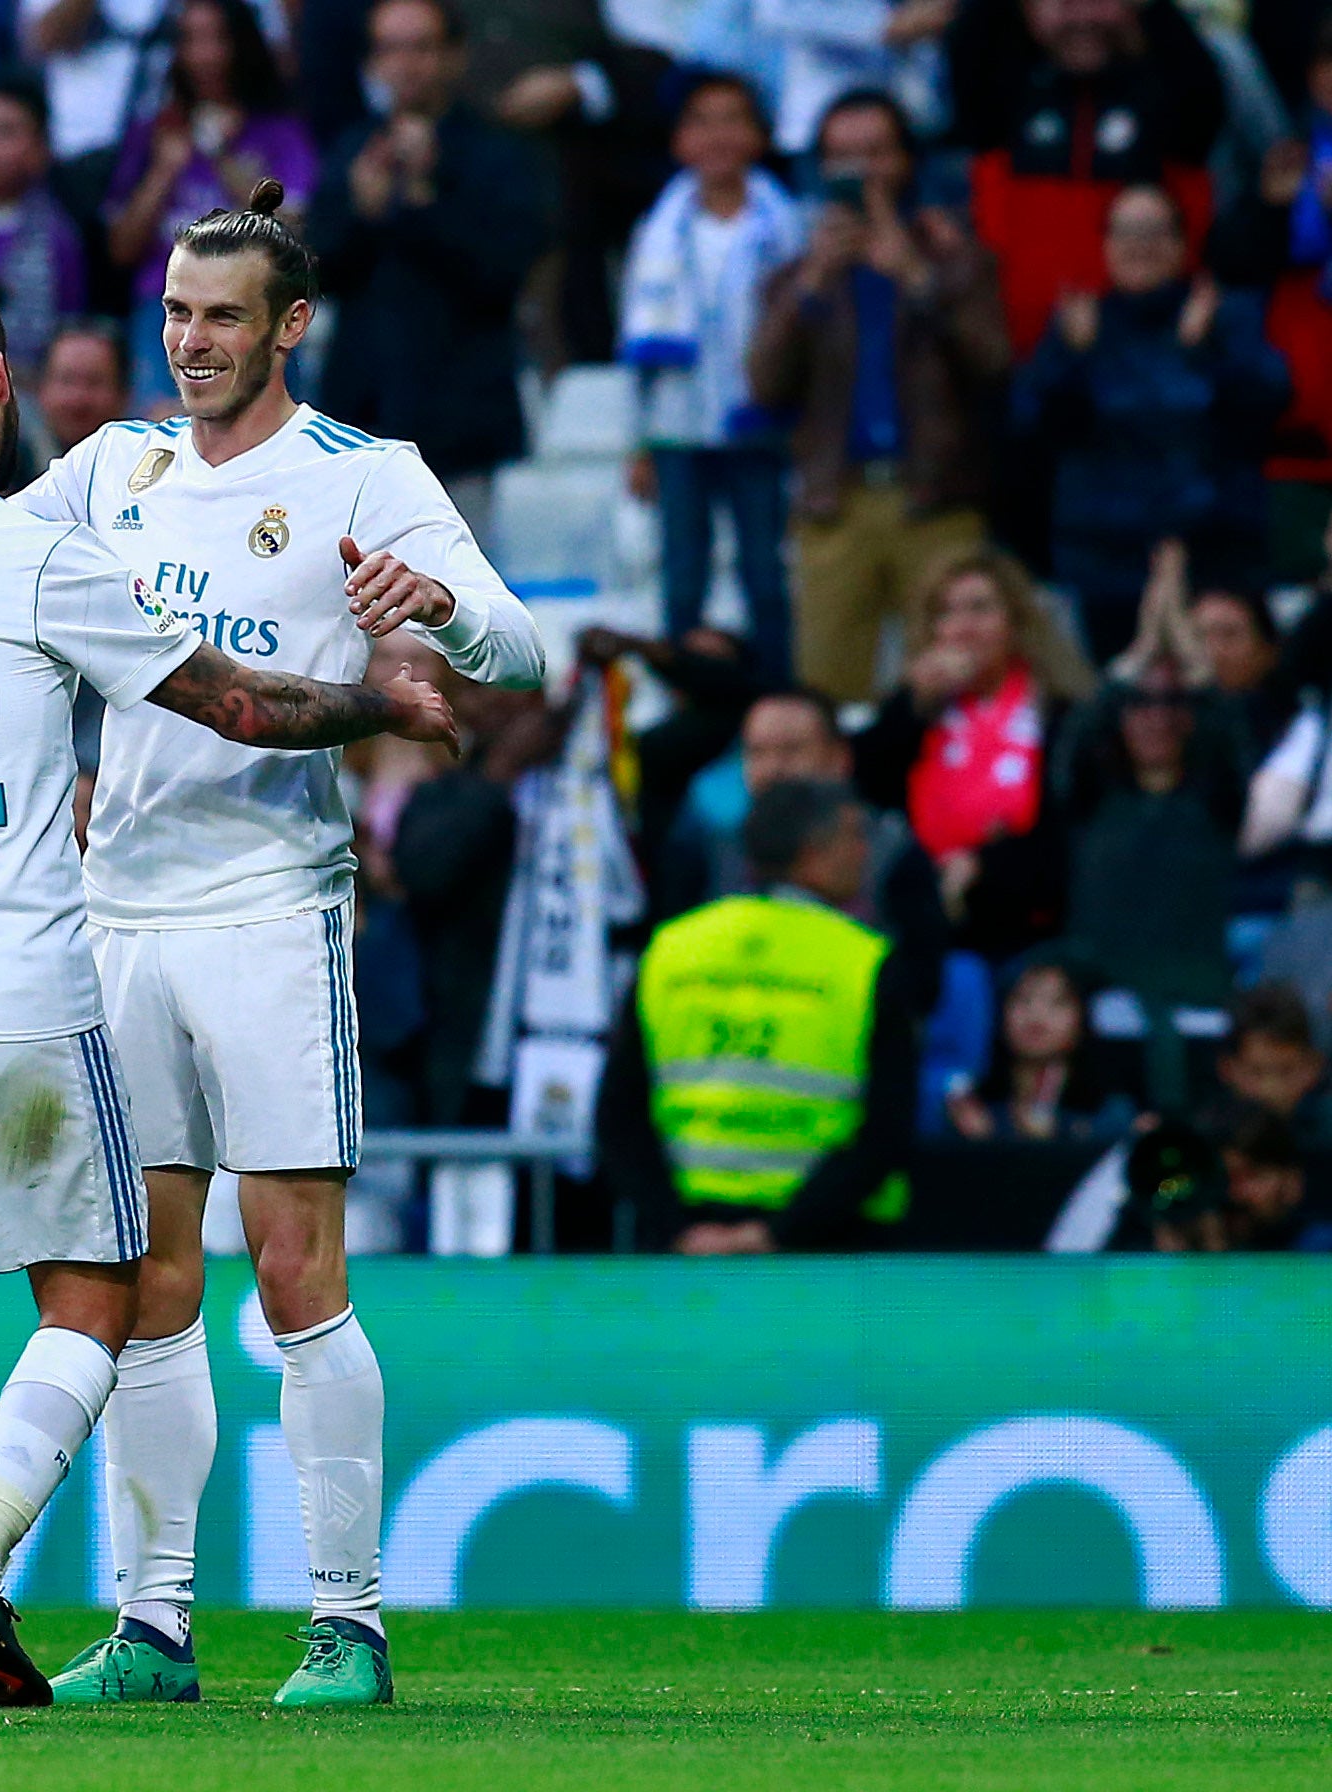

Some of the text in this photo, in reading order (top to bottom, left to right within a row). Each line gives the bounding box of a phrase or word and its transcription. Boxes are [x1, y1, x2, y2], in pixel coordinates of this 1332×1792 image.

[112, 518, 144, 531] adidas
[155, 561, 210, 603] Fly
[170, 607, 279, 657] ates
